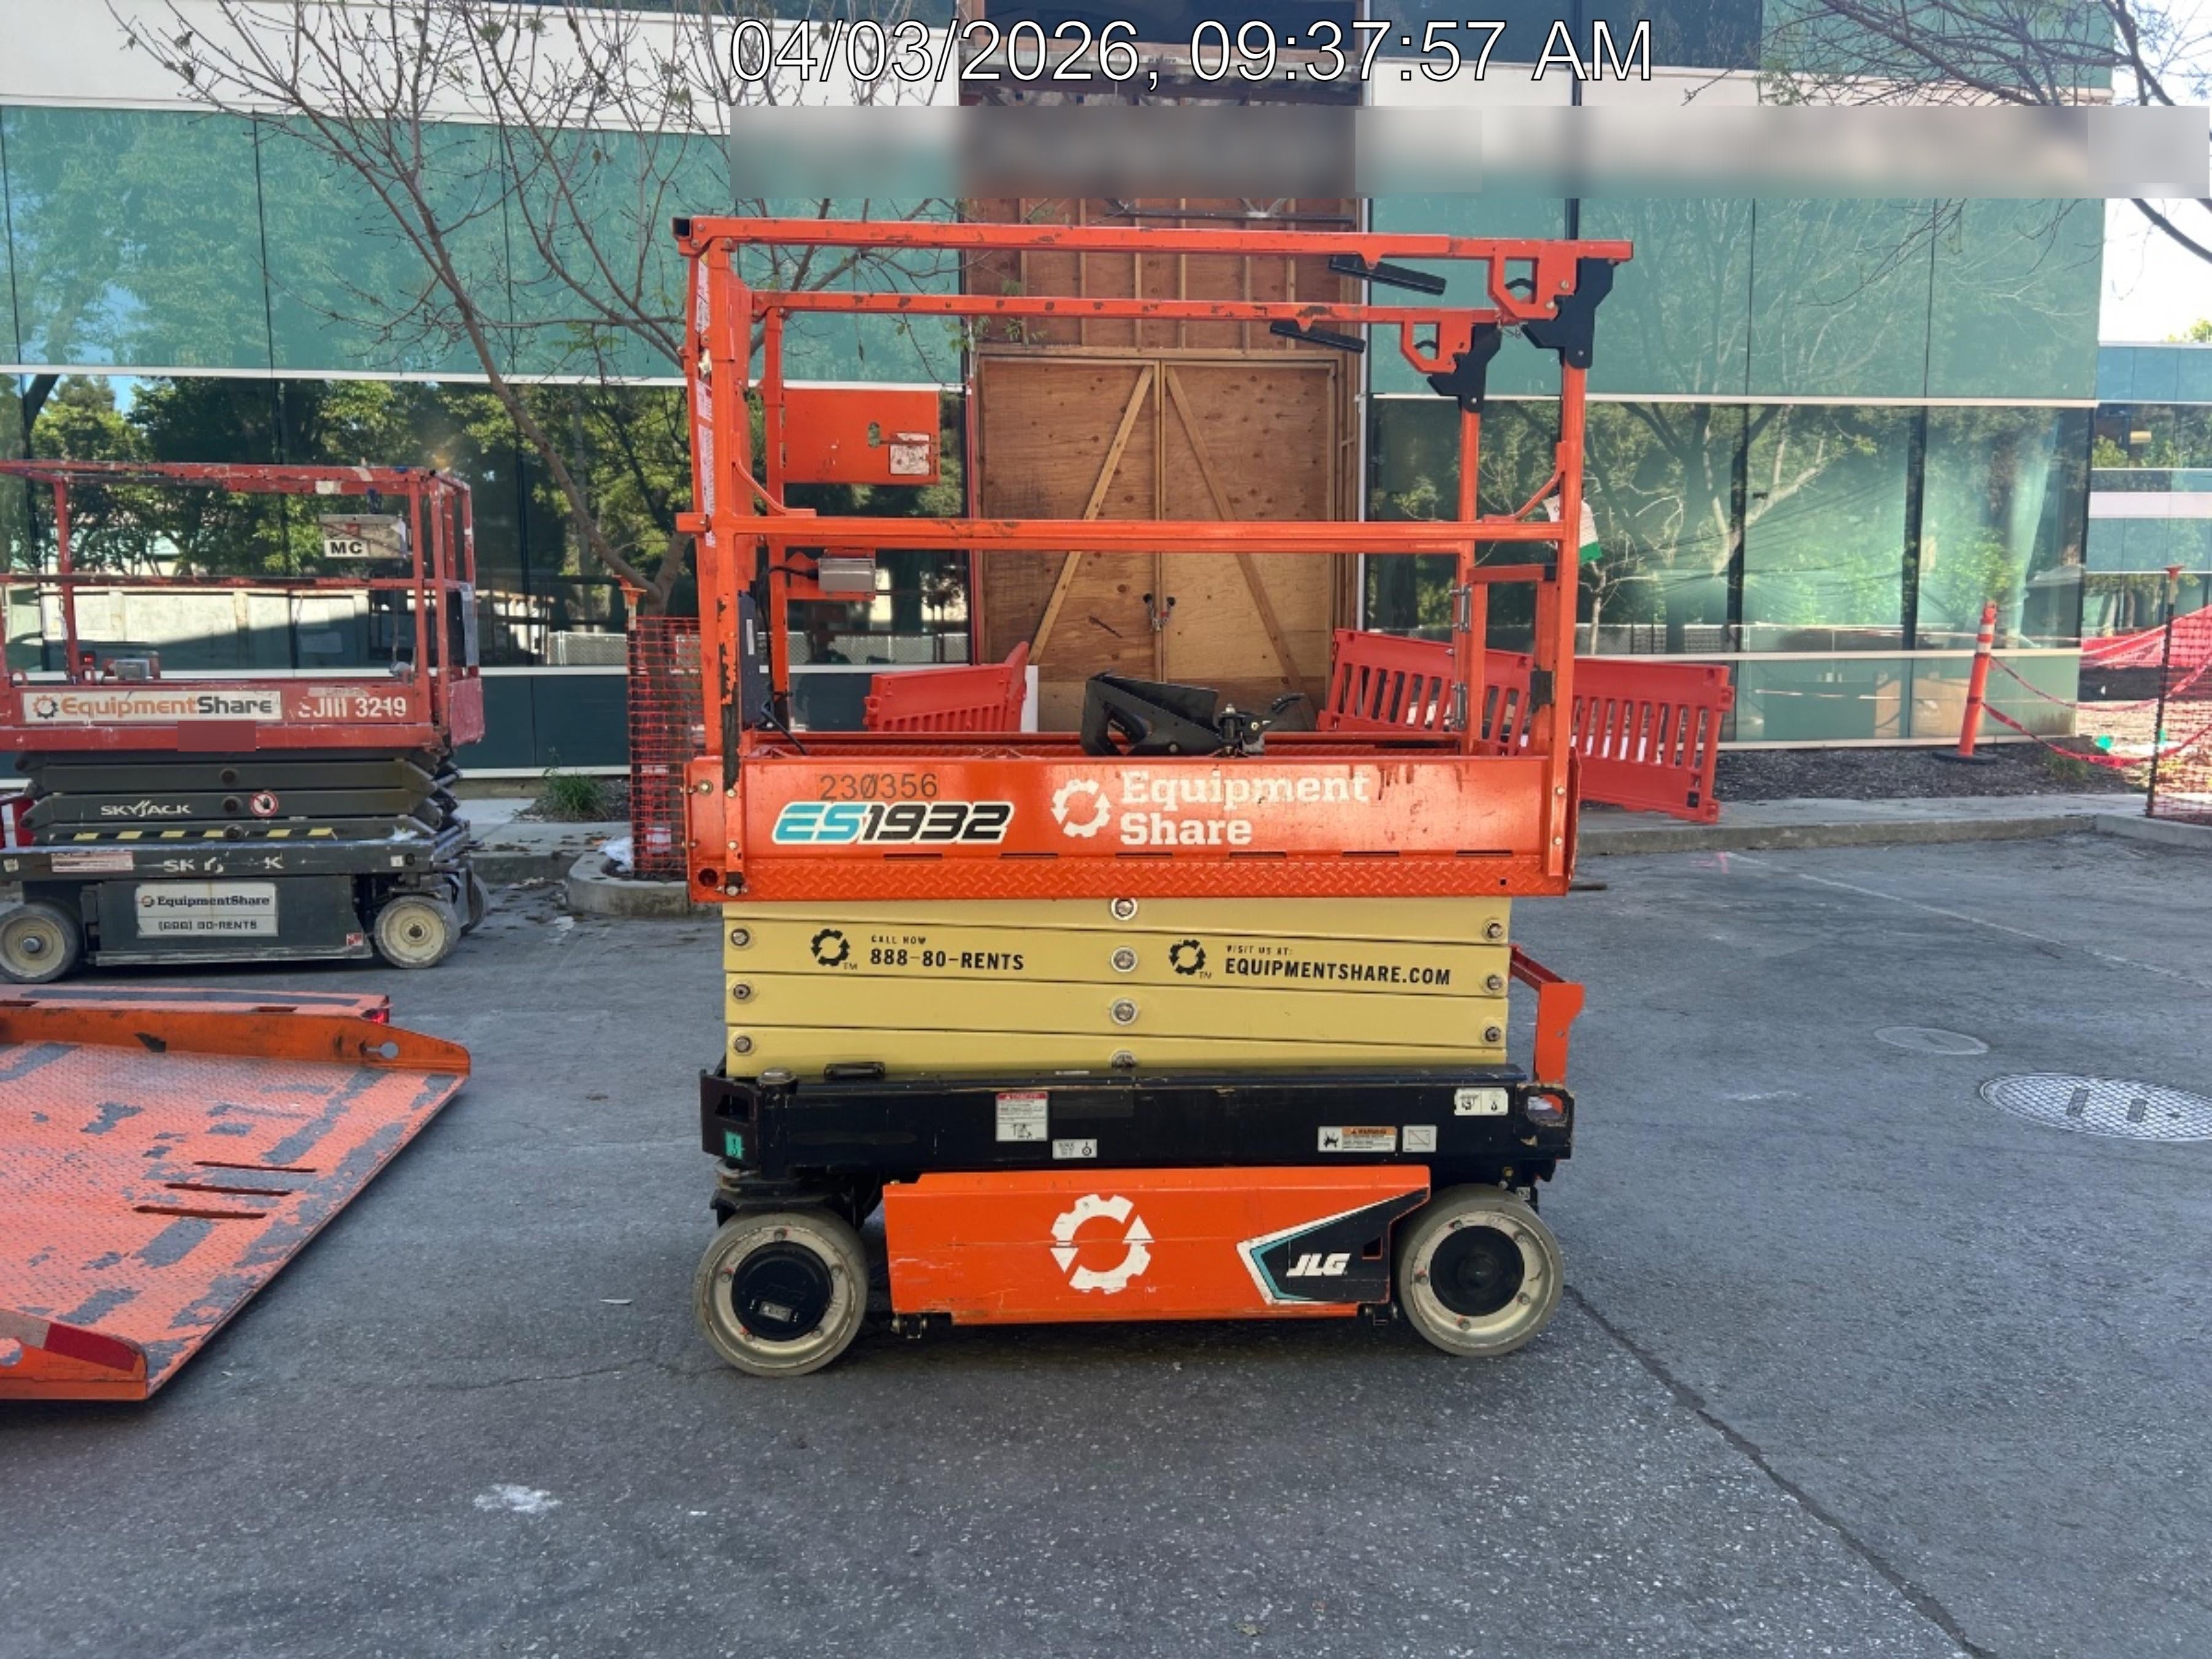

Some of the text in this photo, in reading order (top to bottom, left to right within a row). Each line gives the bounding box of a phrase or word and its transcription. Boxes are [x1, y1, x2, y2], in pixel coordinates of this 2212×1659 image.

[330, 541, 363, 554] MC
[62, 696, 272, 717] EquipmentShare
[1120, 769, 1370, 811] Equipment
[101, 799, 192, 817] SKYJACK
[772, 802, 1014, 843] ES1932
[1120, 812, 1252, 845] Share
[157, 895, 270, 908] EquipmentShare
[871, 935, 927, 945] CALL NOW
[1226, 945, 1253, 954] VISIT
[843, 962, 858, 971] TM
[870, 948, 1024, 970] 888-80-RENTS
[1199, 971, 1212, 979] TM
[1225, 957, 1451, 986] EQUIPMENTSHARE.COM
[1286, 1253, 1351, 1276] JLG
